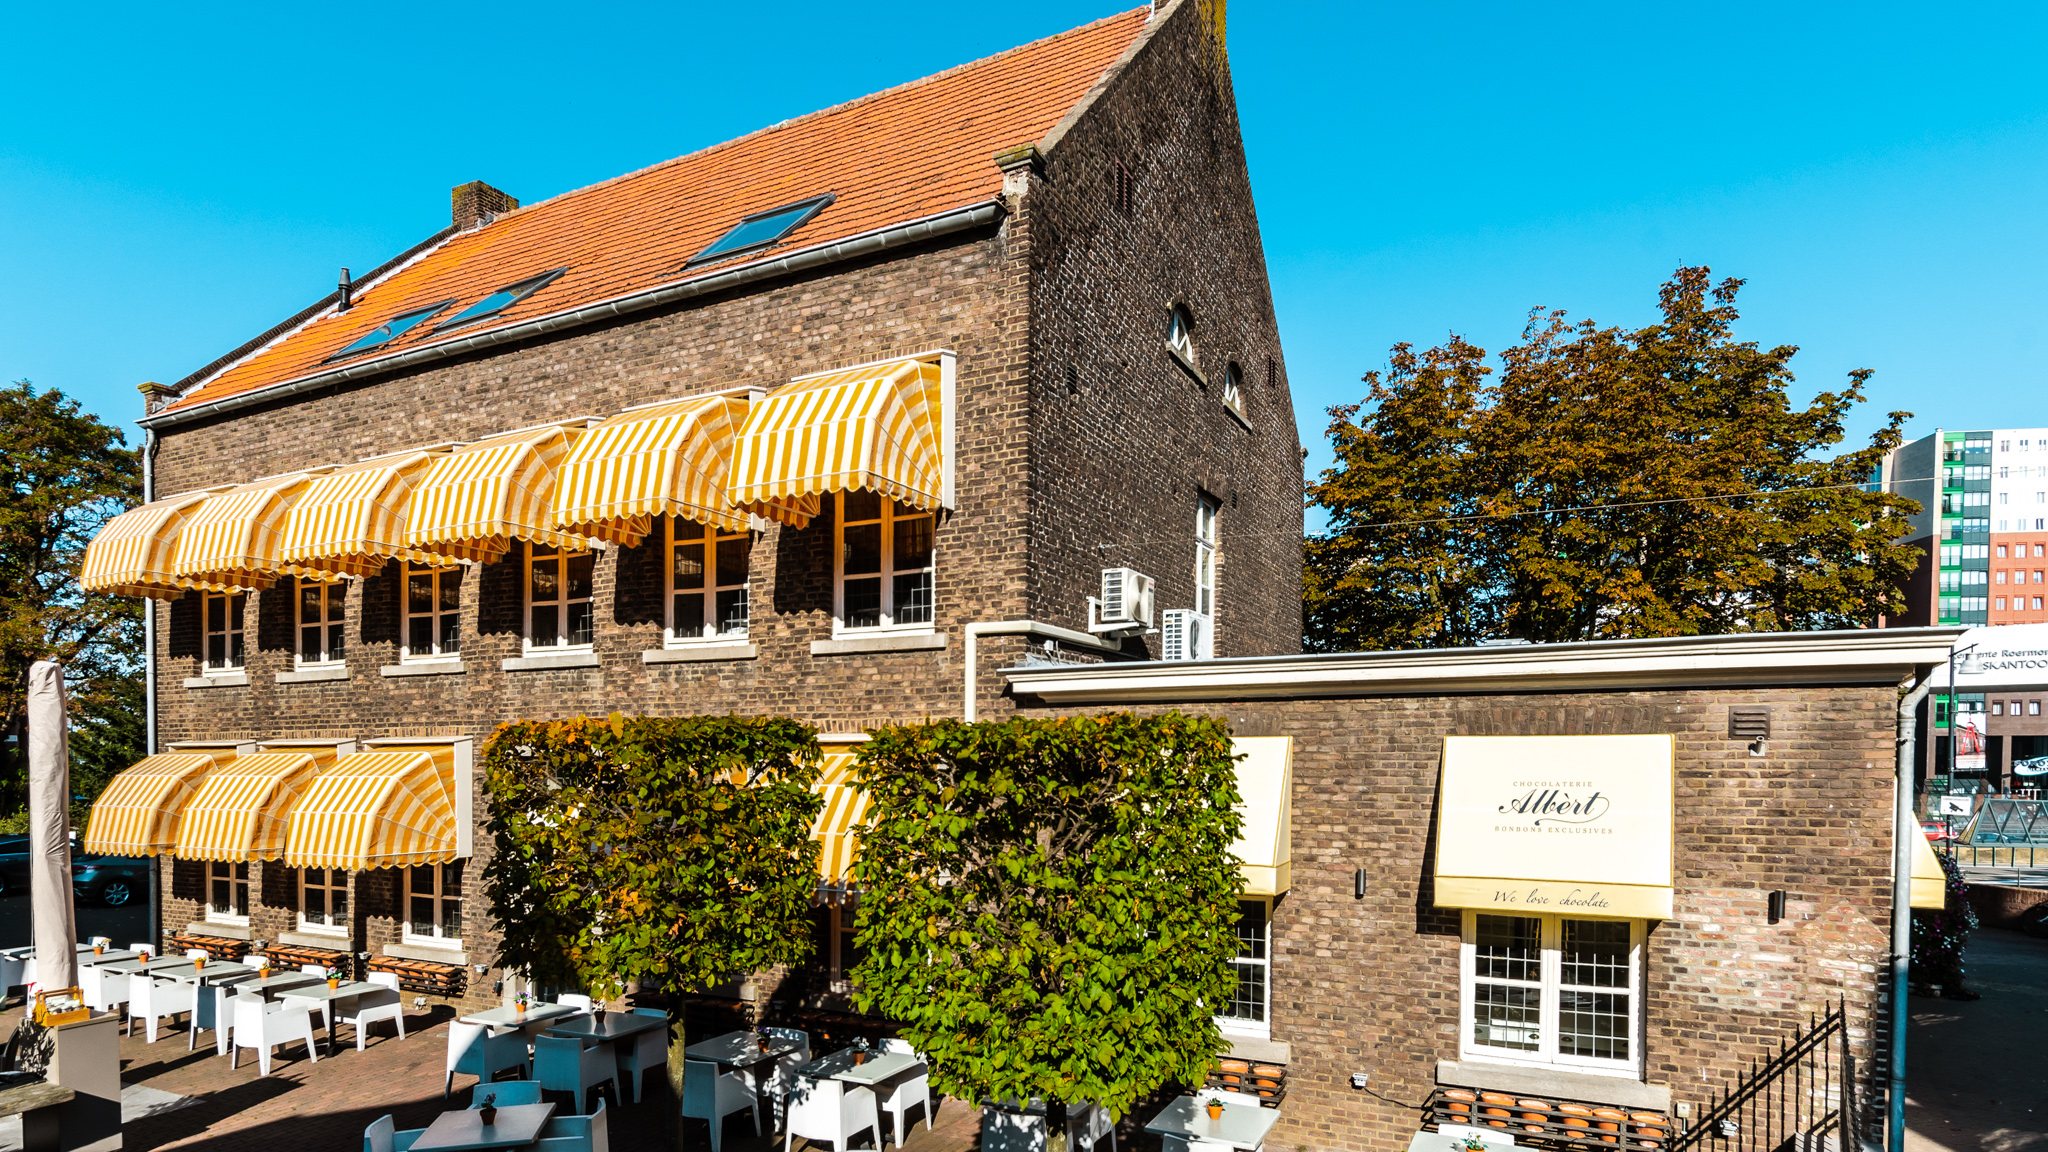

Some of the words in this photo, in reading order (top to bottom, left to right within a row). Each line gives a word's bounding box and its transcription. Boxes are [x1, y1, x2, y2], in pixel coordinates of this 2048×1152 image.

[1498, 788, 1610, 826] Albèrt
[1494, 825, 1542, 833] BONBONS
[1494, 890, 1517, 903] We
[1526, 888, 1550, 904] love
[1559, 888, 1610, 908] chocolate
